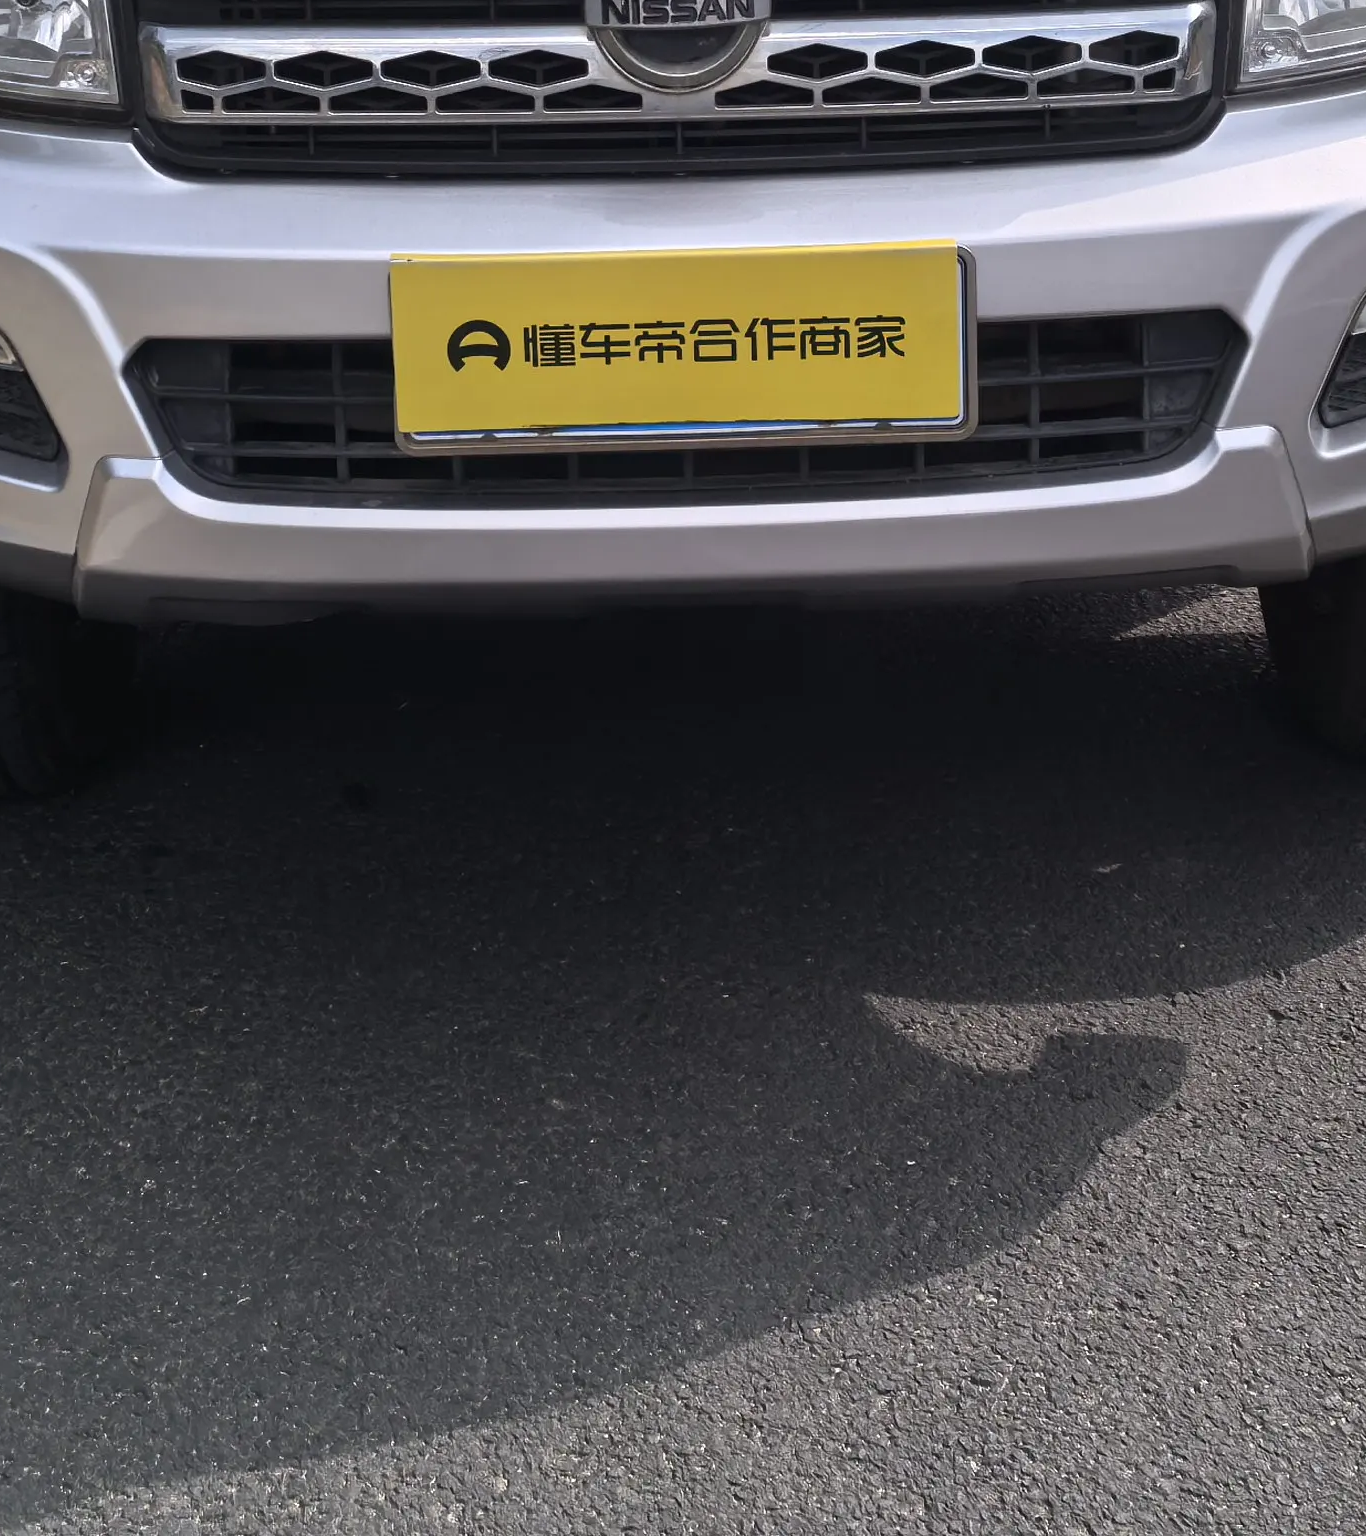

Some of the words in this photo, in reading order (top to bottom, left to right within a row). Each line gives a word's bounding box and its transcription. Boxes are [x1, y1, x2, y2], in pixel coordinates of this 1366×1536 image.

[523, 314, 906, 368] 懂车帝合作商家
